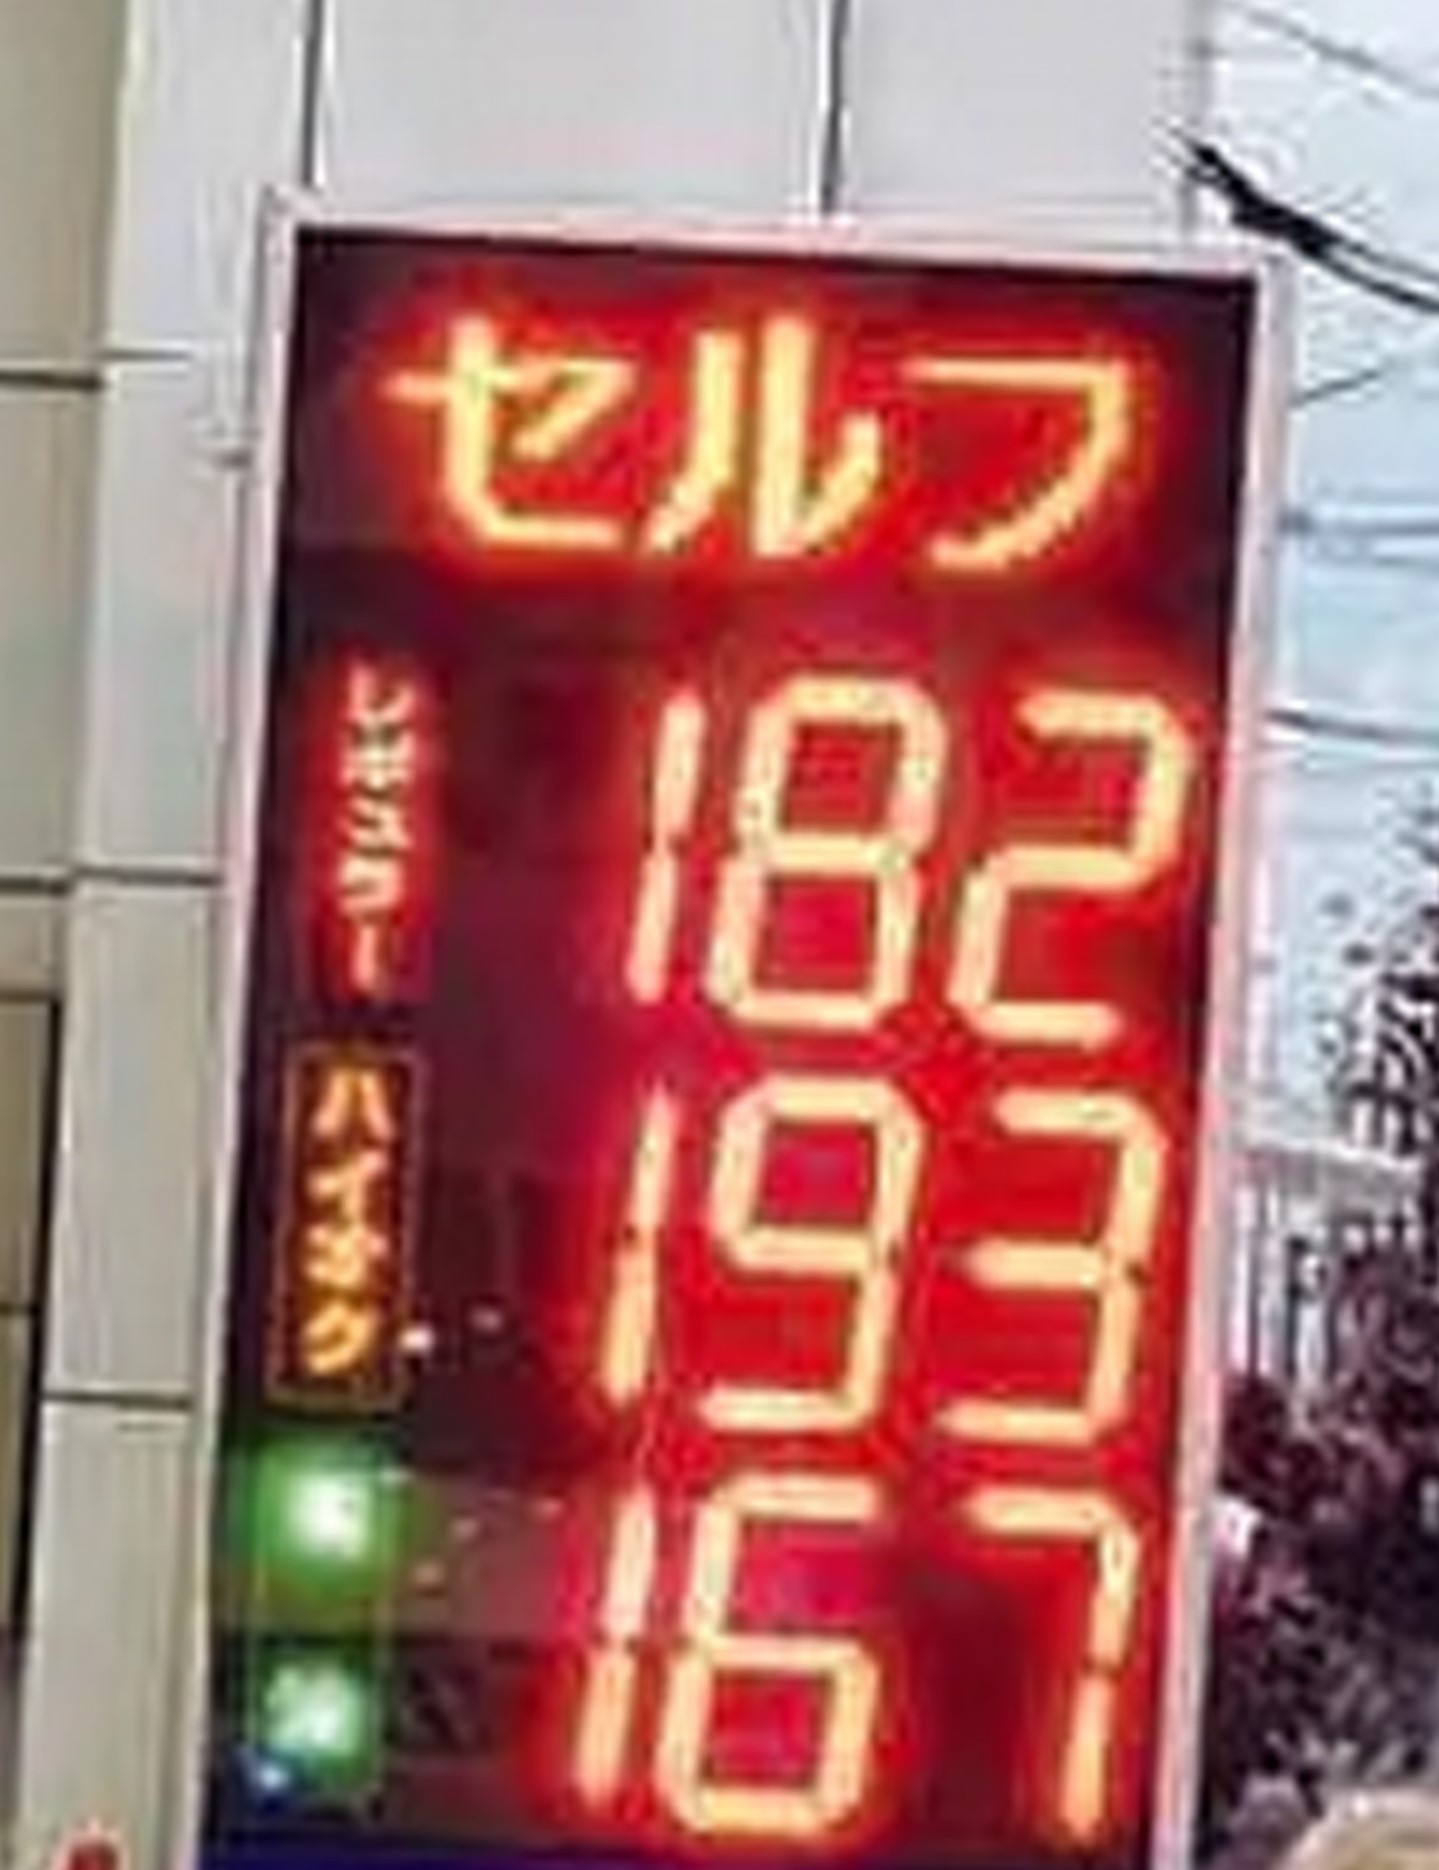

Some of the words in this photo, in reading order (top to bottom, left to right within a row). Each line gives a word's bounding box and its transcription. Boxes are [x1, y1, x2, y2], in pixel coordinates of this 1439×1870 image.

[388, 314, 1135, 570] セルフ
[622, 674, 1198, 1050] 182
[600, 1076, 1172, 1446] 193
[572, 1472, 1140, 1838] 167
